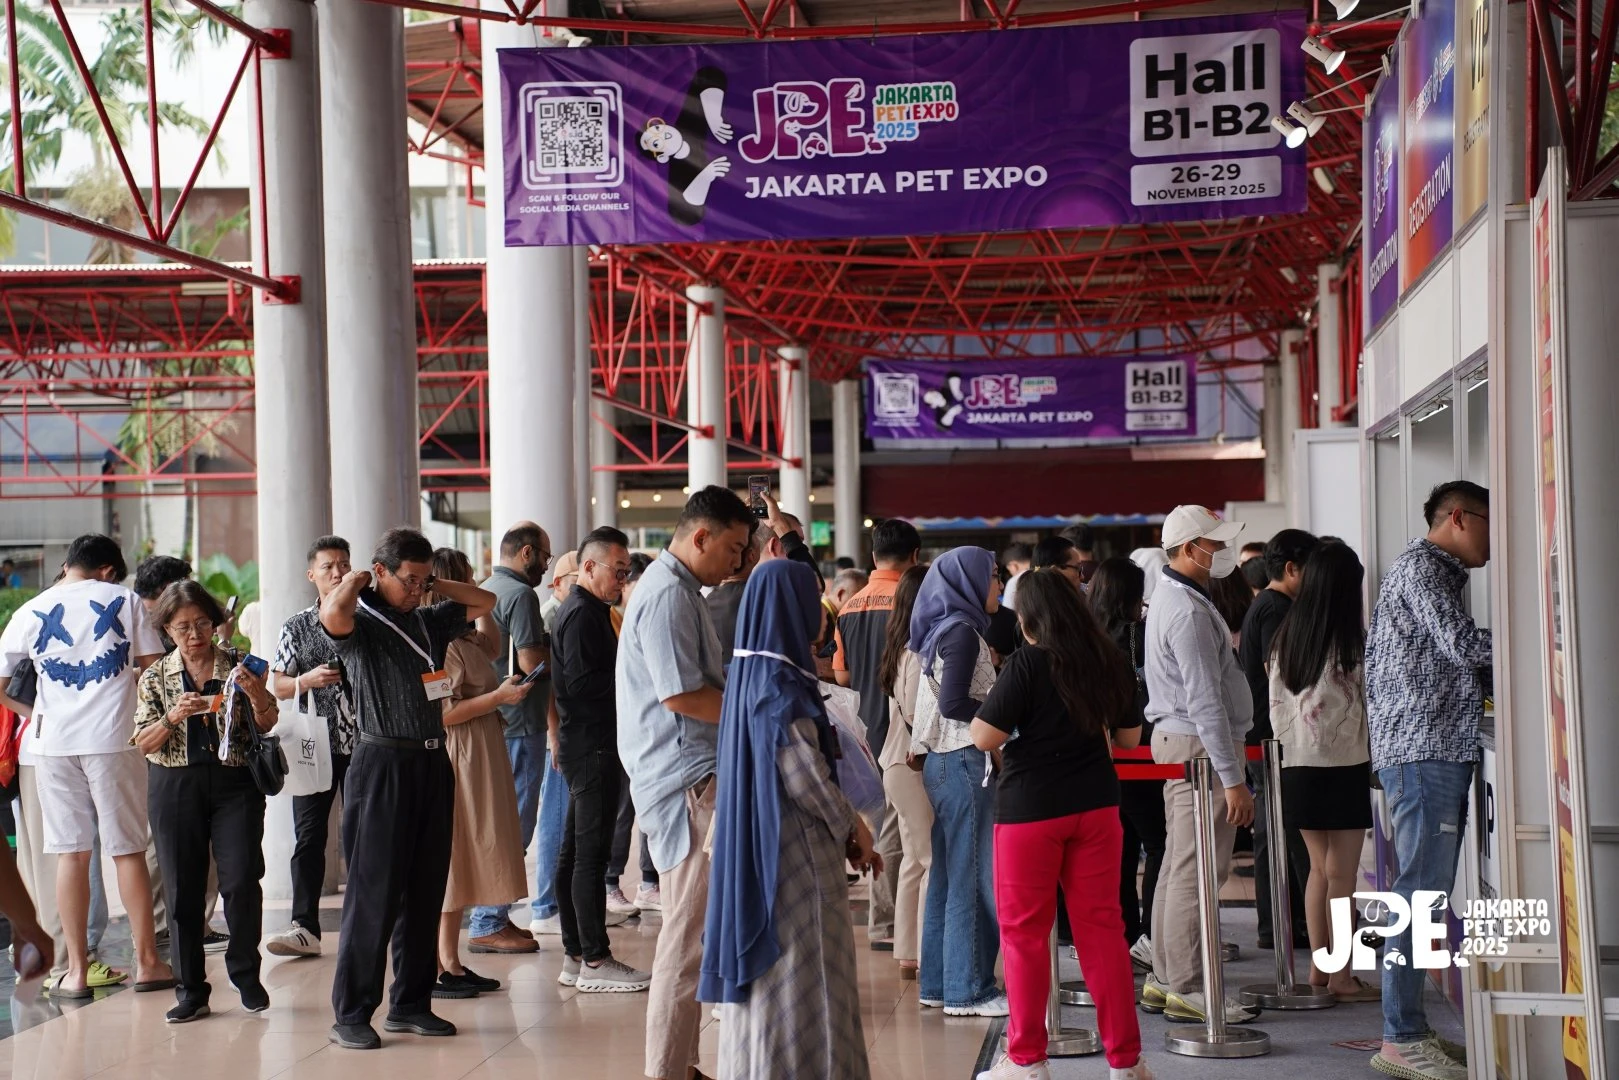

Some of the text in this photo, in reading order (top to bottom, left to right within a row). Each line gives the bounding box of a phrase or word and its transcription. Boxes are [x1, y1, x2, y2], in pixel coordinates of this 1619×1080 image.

[1145, 43, 1265, 98] Hall
[875, 85, 953, 105] JAKARTA
[738, 78, 865, 163] JPE
[876, 103, 956, 121] PET EXPO
[1144, 102, 1270, 141] B1-B2
[877, 122, 916, 139] 2025
[744, 165, 1048, 198] JAKARTA PET EXPO
[1171, 163, 1241, 183] 26-29
[528, 195, 552, 203] SCAN
[562, 193, 599, 202] FOLLOW
[600, 192, 620, 200] OUR
[1147, 183, 1266, 200] NOVEMBER 2025
[1409, 152, 1451, 239] REGISTRATION
[520, 203, 630, 213] SOCIAL MEDIA CHANNELS
[1132, 366, 1181, 386] Hall
[1132, 390, 1183, 404] B1-B2
[967, 411, 1094, 423] JAKARTA PET EXPO
